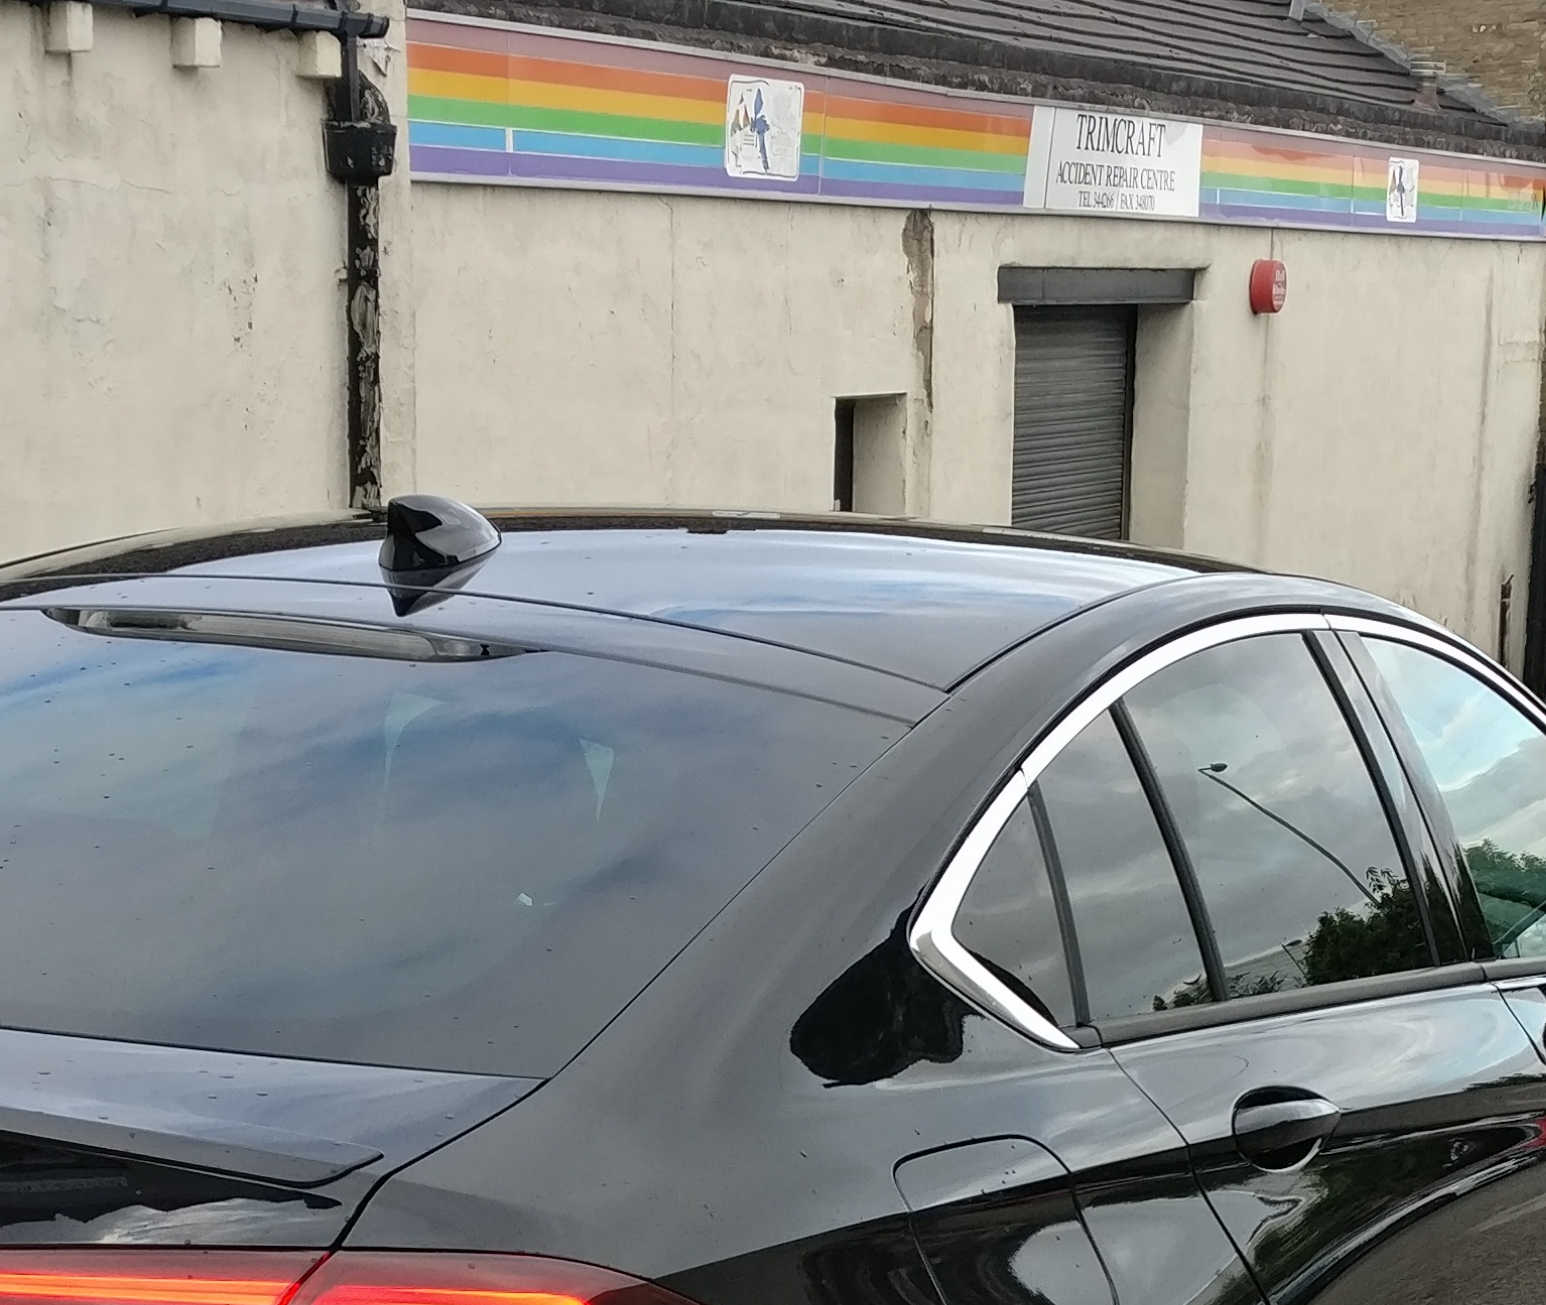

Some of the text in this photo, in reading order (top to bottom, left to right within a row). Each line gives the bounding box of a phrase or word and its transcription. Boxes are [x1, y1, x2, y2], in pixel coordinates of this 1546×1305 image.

[1076, 113, 1166, 158] TRIMCRAFT
[1055, 160, 1176, 192] ACCIDENT REPAIR CENTRE
[1078, 190, 1092, 208] TEL
[1120, 193, 1134, 210] FAX
